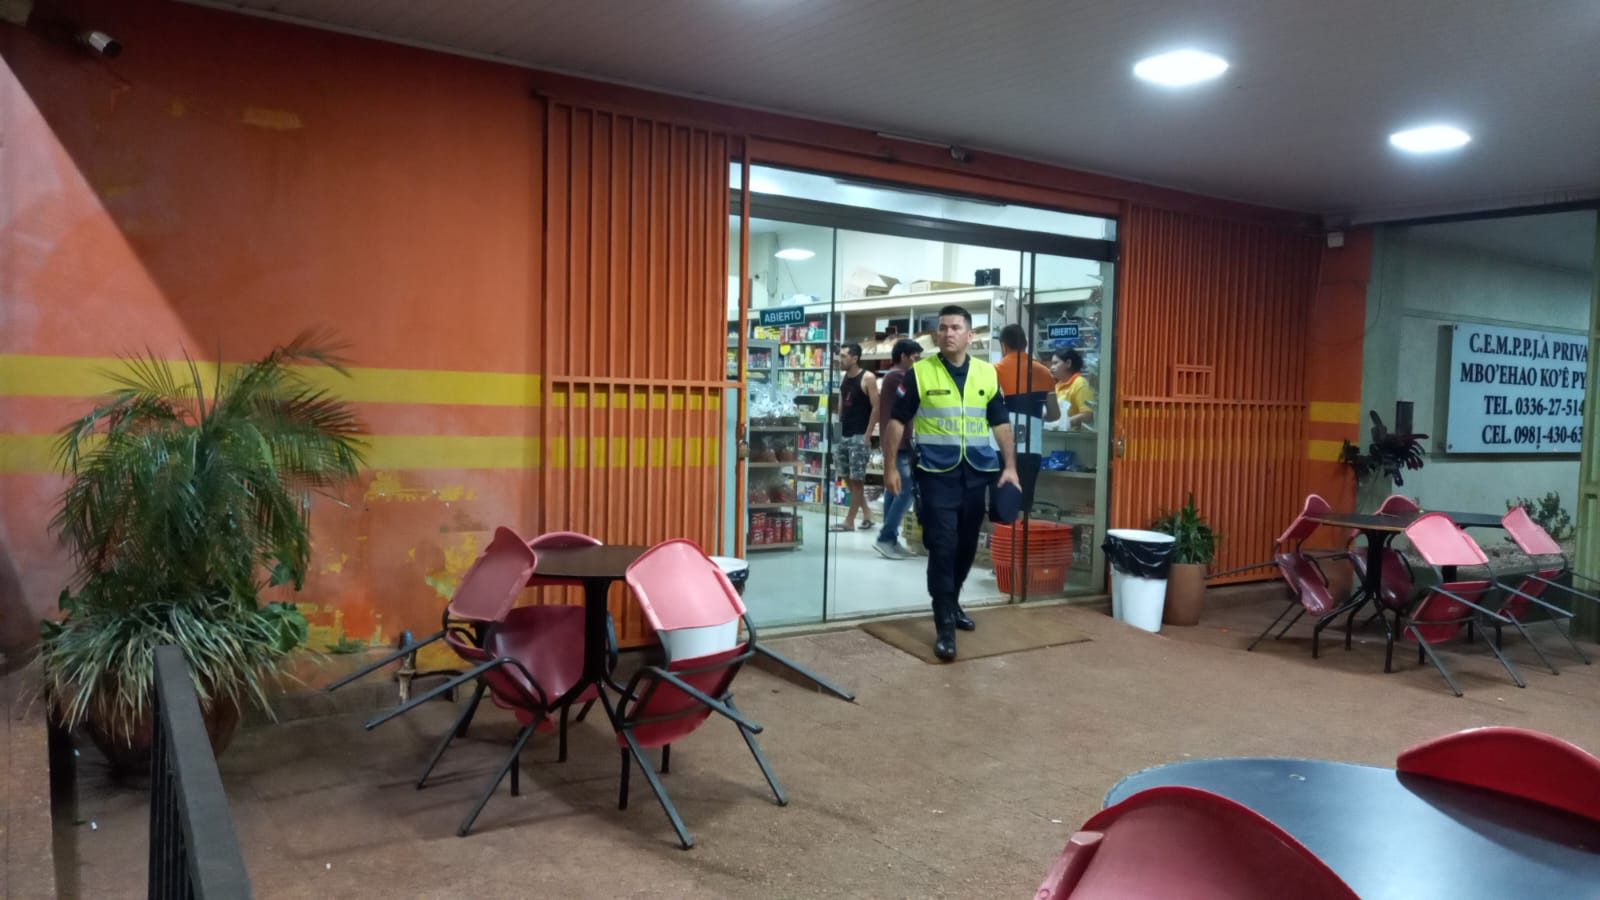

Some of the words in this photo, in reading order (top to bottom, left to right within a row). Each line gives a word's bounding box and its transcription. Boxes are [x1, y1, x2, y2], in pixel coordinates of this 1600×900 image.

[764, 310, 801, 322] ABIERTO
[1050, 327, 1077, 336] ABIERTO
[1460, 362, 1537, 386] MBO’EHAO
[1484, 395, 1513, 415] TEL.
[1482, 425, 1512, 444] CEL.
